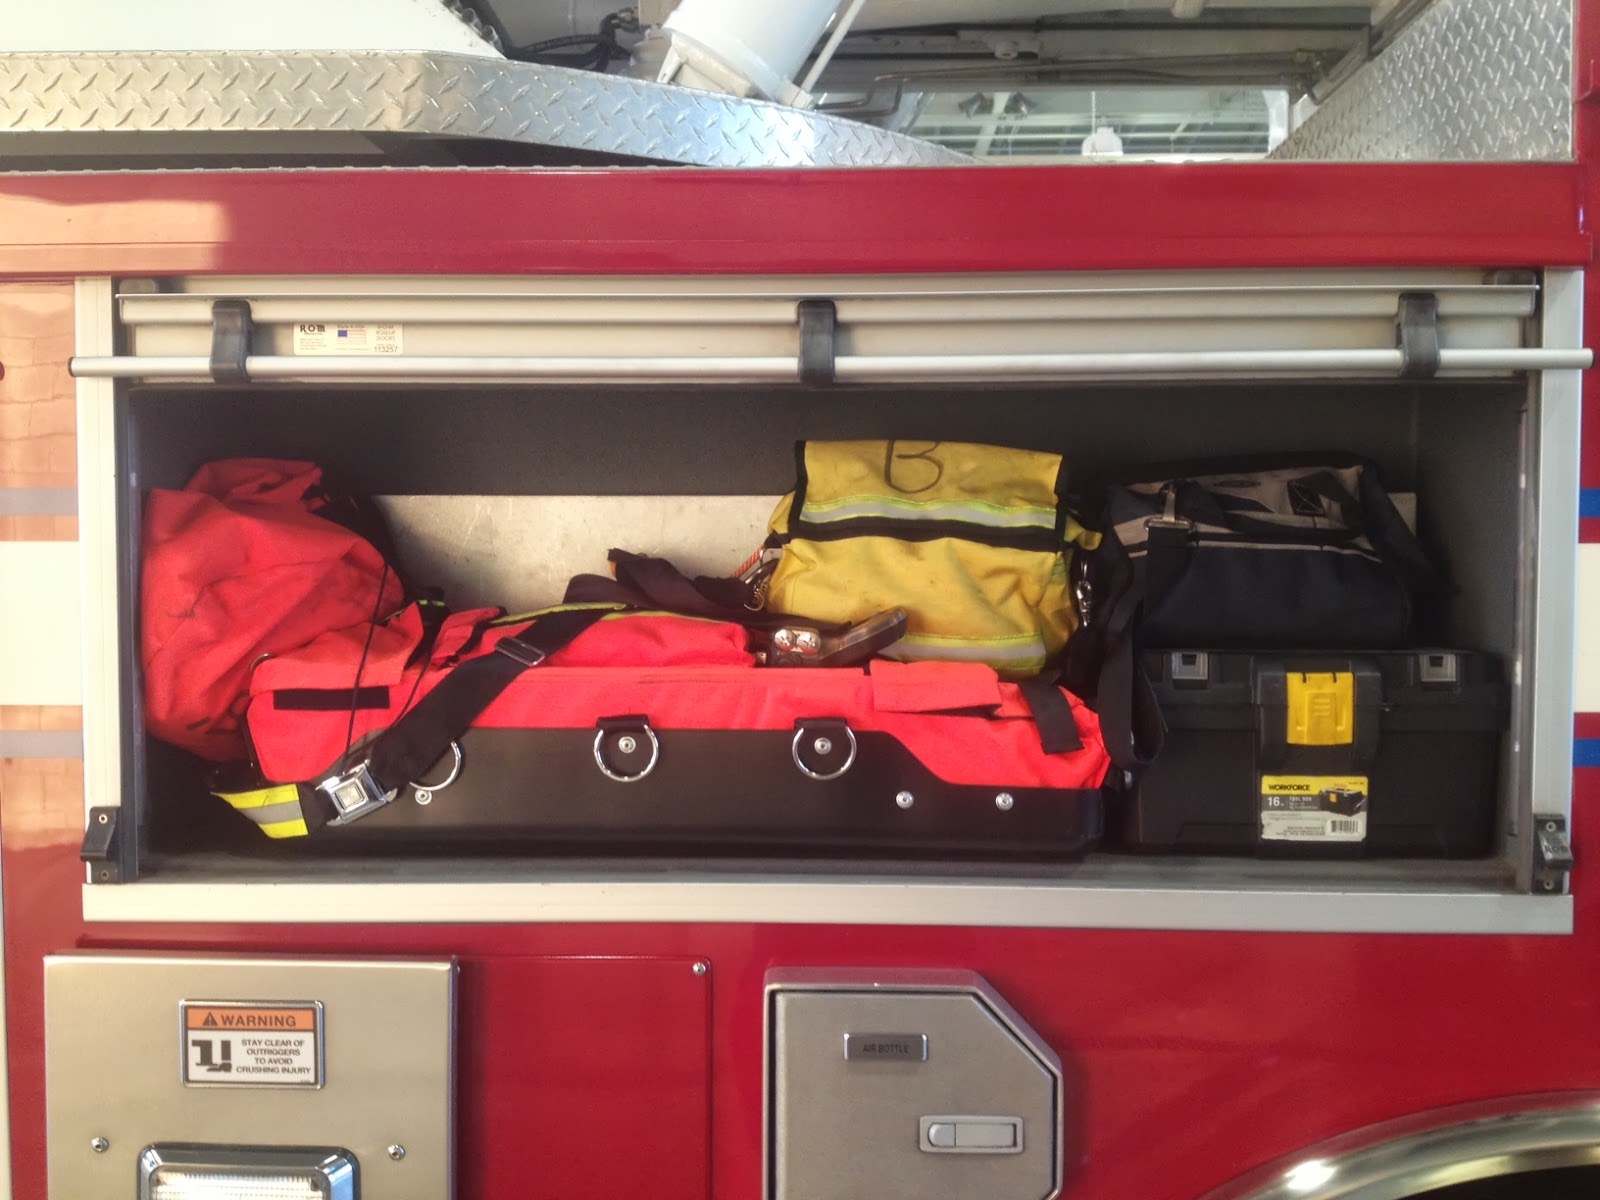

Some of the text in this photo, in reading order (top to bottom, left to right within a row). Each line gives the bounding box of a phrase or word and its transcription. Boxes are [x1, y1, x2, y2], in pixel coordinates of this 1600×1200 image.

[1267, 796, 1281, 807] 16
[221, 1014, 297, 1027] WARNING
[241, 1039, 262, 1047] STAY
[264, 1039, 292, 1047] CLEAR
[246, 1048, 301, 1056] OUTRIGGERS
[863, 1043, 909, 1054] AIR BOTTLE
[254, 1057, 293, 1065] TO AVOID
[236, 1065, 311, 1075] CRUSHING INJURY
